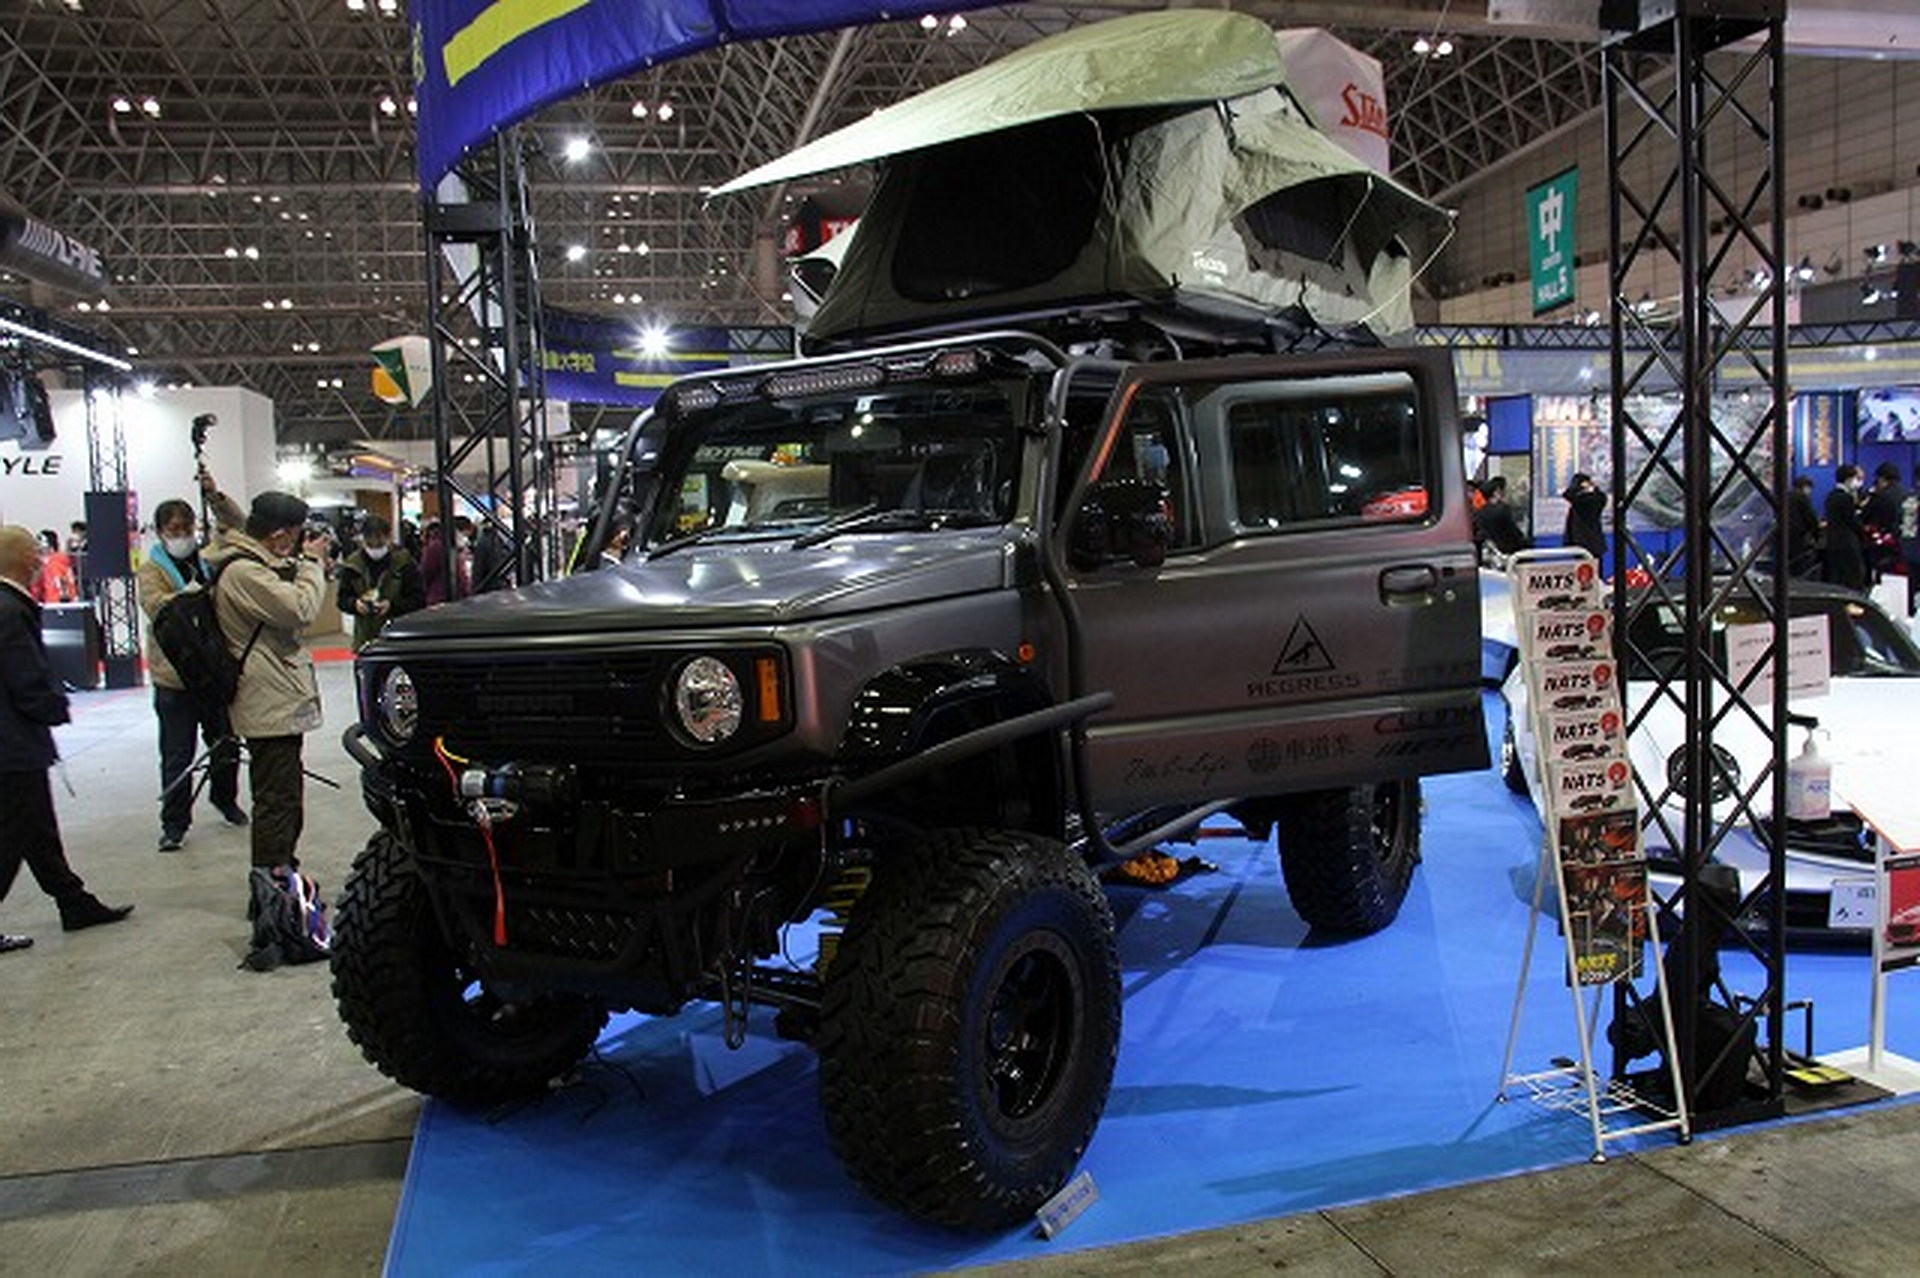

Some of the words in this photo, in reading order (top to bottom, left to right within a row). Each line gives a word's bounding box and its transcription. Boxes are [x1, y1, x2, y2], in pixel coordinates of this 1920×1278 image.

[1539, 187, 1563, 253] 中
[1528, 572, 1575, 590] NATS
[1537, 623, 1585, 640] NATS
[1544, 674, 1591, 692] NATS
[1553, 722, 1599, 740] NATS
[1562, 772, 1606, 790] NATS
